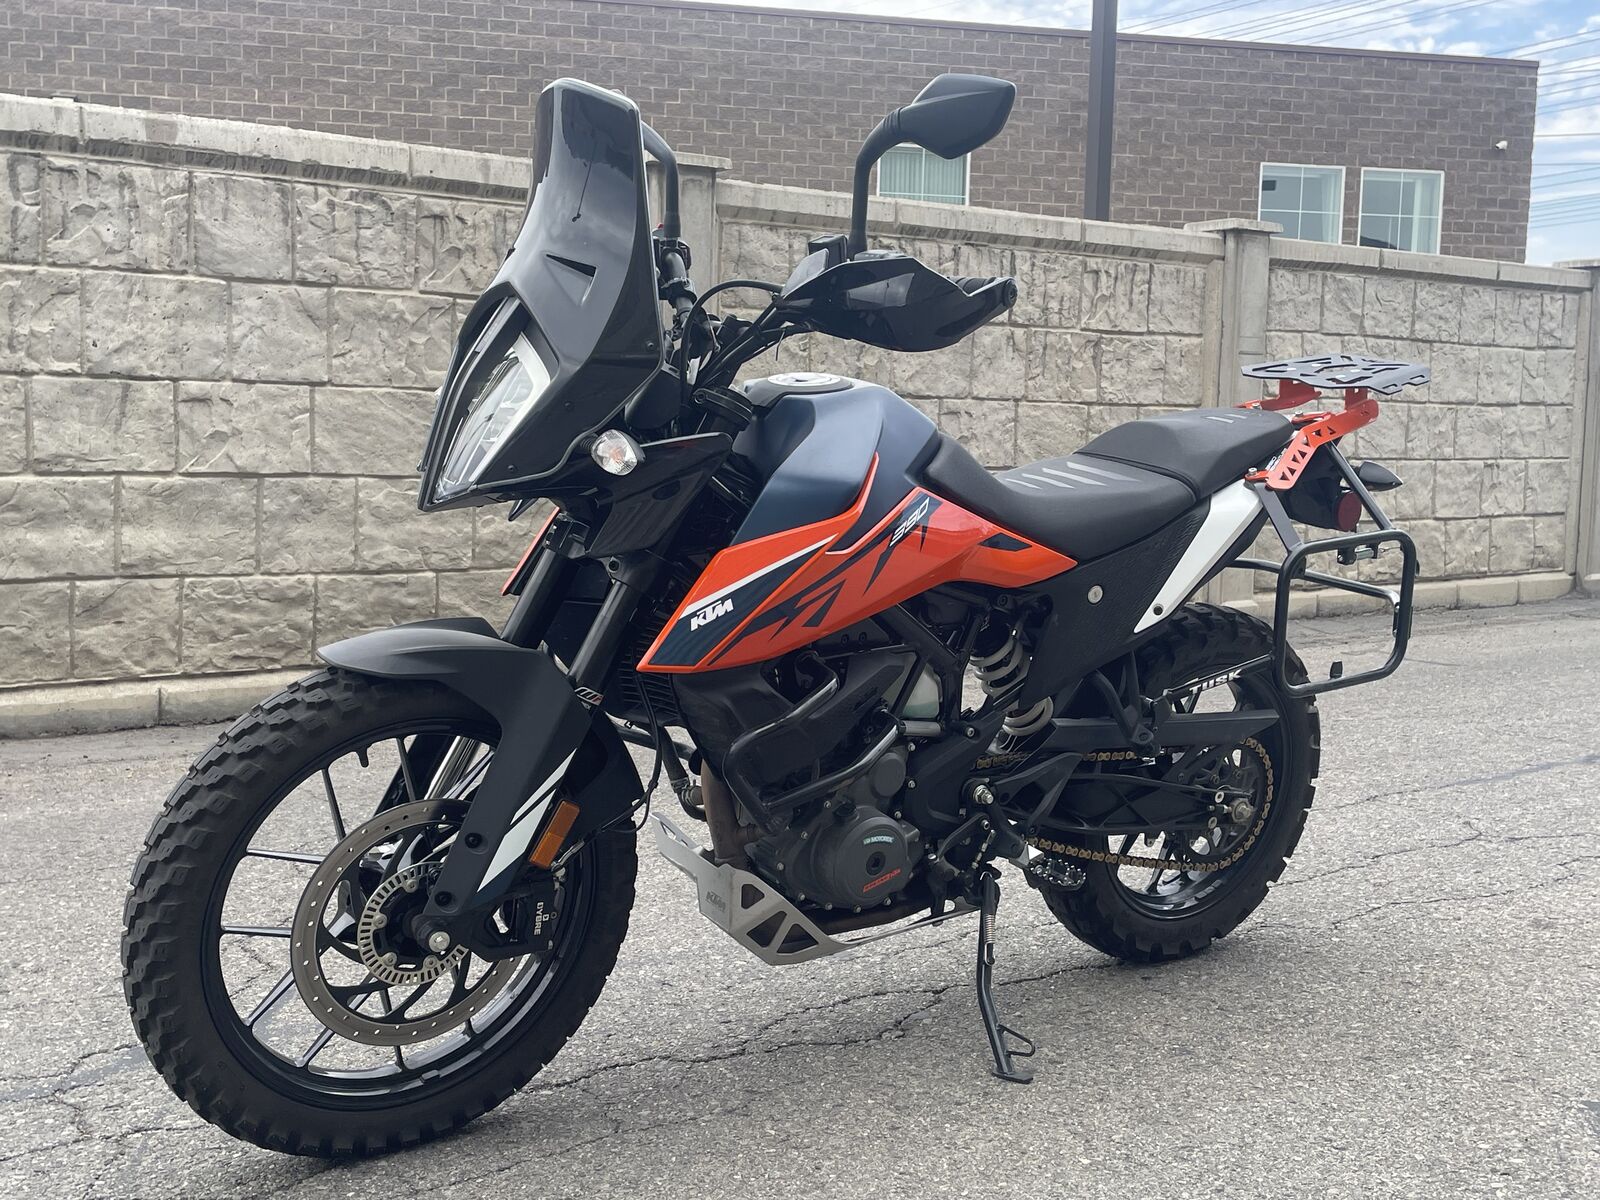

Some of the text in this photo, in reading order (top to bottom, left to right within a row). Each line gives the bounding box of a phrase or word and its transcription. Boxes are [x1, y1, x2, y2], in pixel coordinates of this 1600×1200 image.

[889, 497, 930, 547] 390
[690, 598, 734, 632] KTM
[1189, 668, 1242, 694] TUSK
[533, 901, 544, 936] BYBRE
[705, 890, 726, 913] KTM
